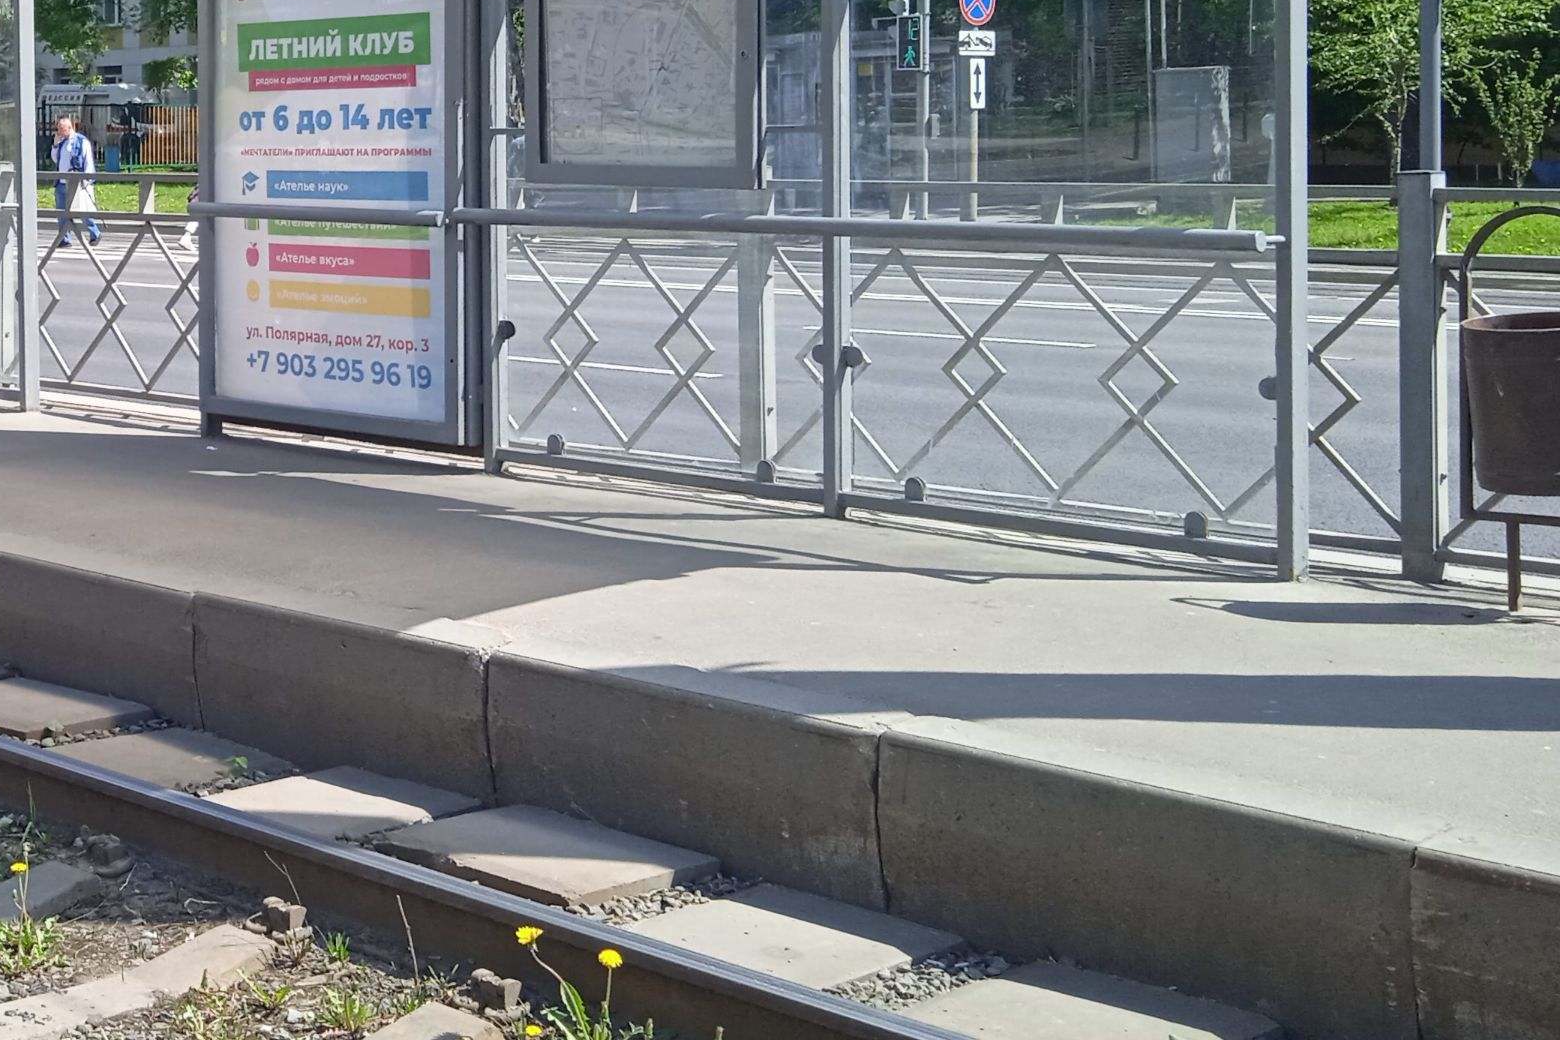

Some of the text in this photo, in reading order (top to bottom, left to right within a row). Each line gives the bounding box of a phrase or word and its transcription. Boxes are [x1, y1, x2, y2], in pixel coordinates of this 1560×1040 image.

[908, 18, 920, 40] 12
[248, 28, 415, 60] ЛЕТНИЙ КЛУБ
[255, 77, 280, 86] рядом
[286, 76, 312, 85] домом
[313, 76, 328, 84] для
[328, 73, 351, 83] детей
[360, 72, 407, 83] подростков
[240, 104, 432, 134] от 6 до 14 лет
[241, 147, 432, 157] «МЕЧТАТЕЛИ» ПРИГЛАШАЮТ НА ПРОГРАММЫ
[274, 179, 349, 195] «Ателье наук»
[276, 251, 355, 267] «Ателье вкуса»
[246, 325, 429, 356] ул. Полярная, дом 27, кор. 3
[246, 350, 432, 390] +7 903 295 96 19
